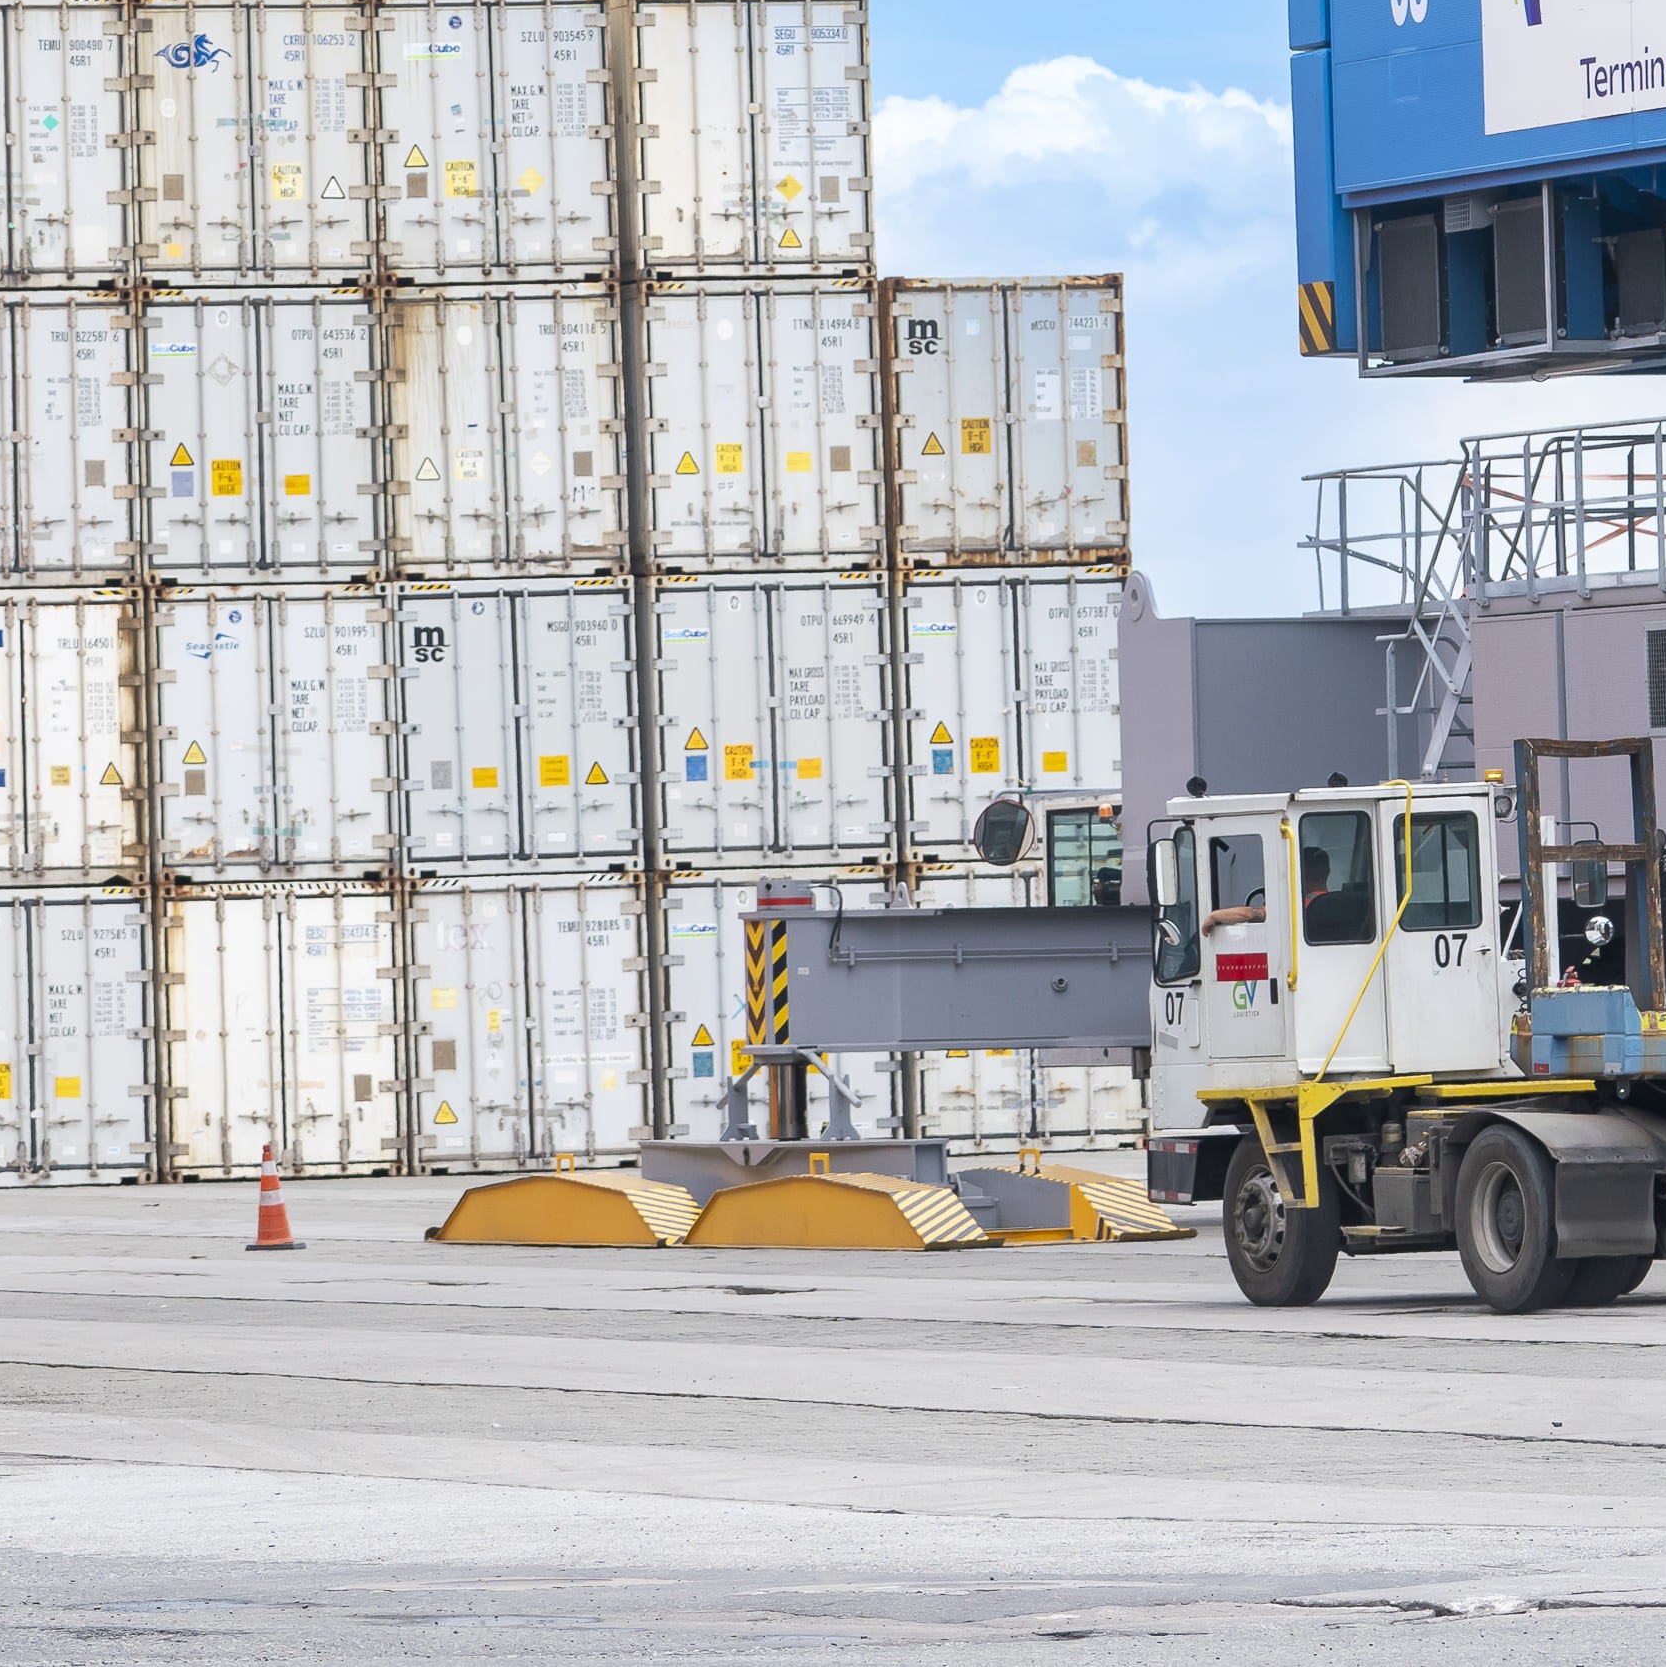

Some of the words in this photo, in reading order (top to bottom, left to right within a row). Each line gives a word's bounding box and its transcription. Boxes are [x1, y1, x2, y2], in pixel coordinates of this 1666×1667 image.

[520, 31, 545, 43] SZLU
[552, 30, 585, 42] 903545
[38, 39, 61, 51] TEMU
[69, 39, 102, 51] 900490
[553, 49, 577, 61] 45R1
[75, 331, 108, 342] 822587
[322, 329, 356, 340] 643536
[322, 348, 343, 359] 45R1
[574, 619, 608, 631] 903960
[833, 614, 864, 625] 669949
[304, 627, 326, 638] SZLU
[185, 642, 239, 650] Seacstle
[789, 694, 825, 706] PAYLOAD
[1434, 933, 1468, 969] 07
[1165, 991, 1185, 1025] 07
